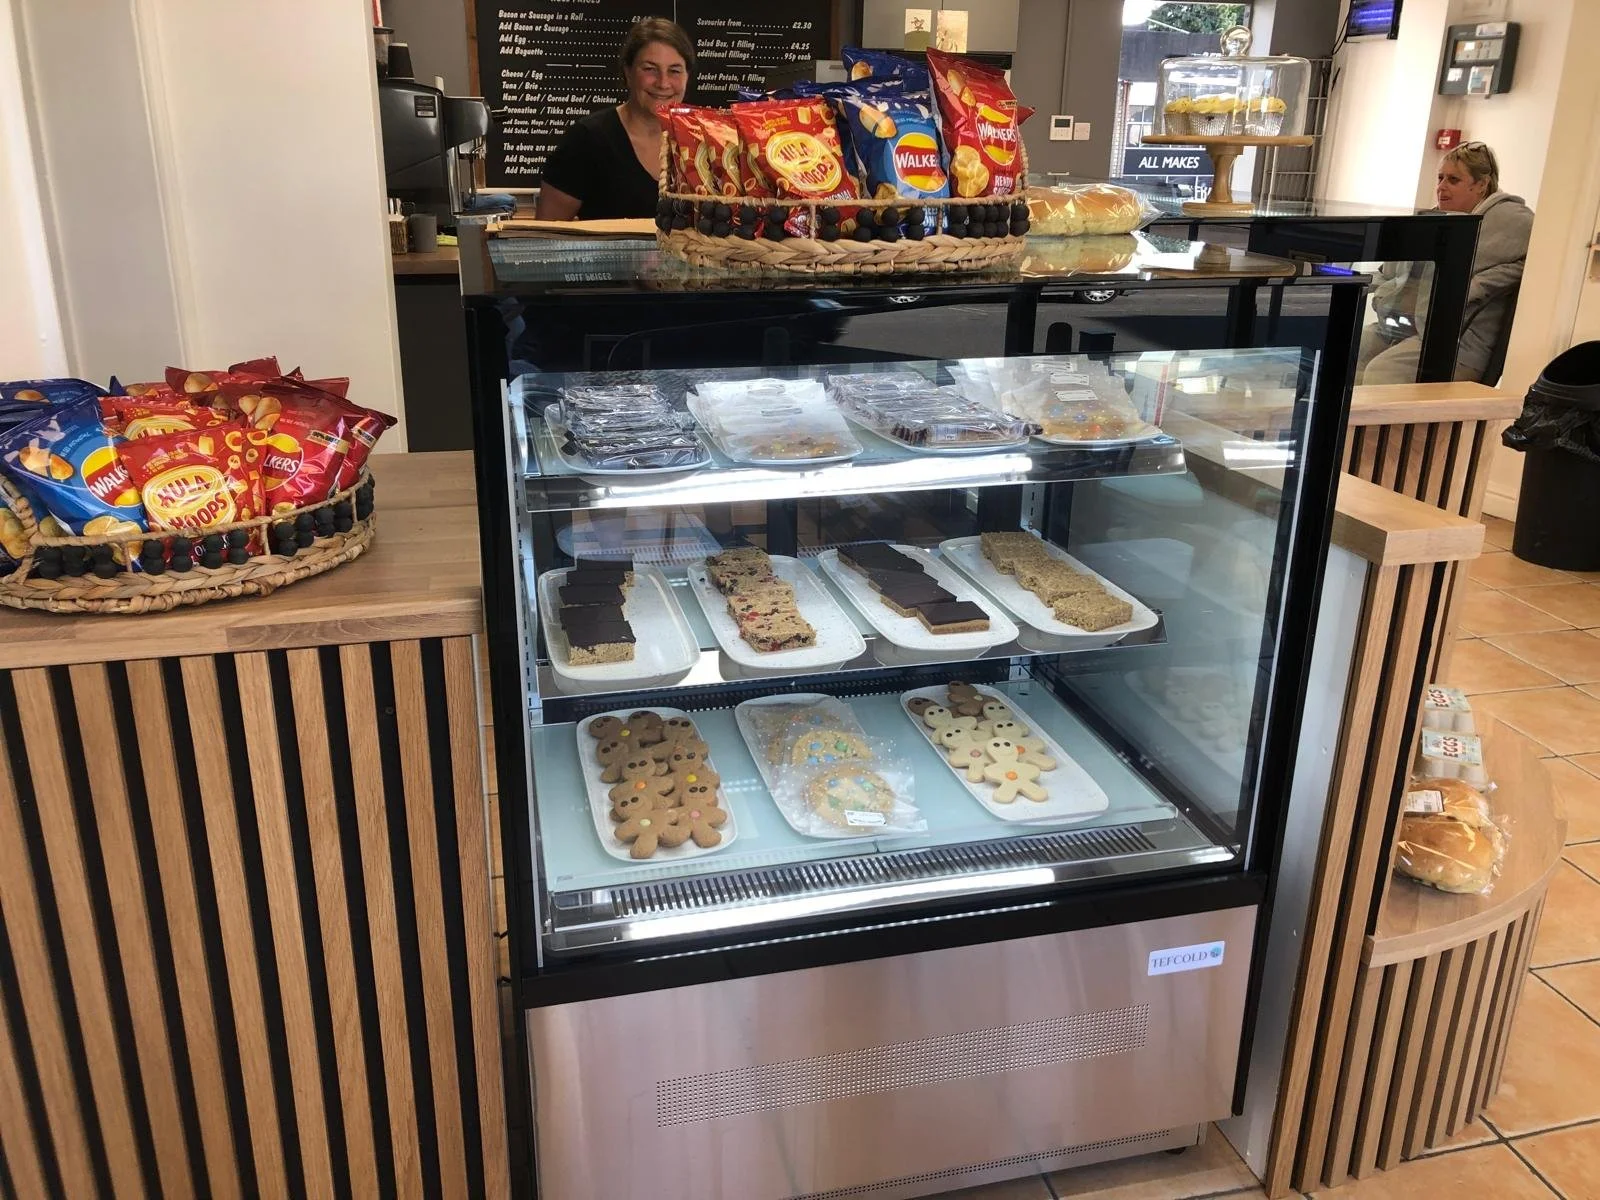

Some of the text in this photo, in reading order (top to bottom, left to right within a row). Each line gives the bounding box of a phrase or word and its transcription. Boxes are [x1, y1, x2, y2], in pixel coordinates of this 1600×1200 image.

[498, 9, 518, 19] Bacon
[528, 10, 555, 22] Sausage
[556, 11, 563, 21] in
[570, 12, 584, 21] Roll
[498, 21, 513, 31] Add
[513, 22, 534, 32] Bacon
[543, 23, 570, 35] Sausage
[696, 17, 813, 30] Savouries from £2.30
[499, 34, 527, 45] Add Egg
[696, 38, 715, 48] Salad
[736, 39, 756, 51] filling
[499, 45, 544, 57] Add Baguette
[696, 49, 812, 62] additional fillings 95p each
[501, 69, 524, 78] Cheese
[531, 70, 544, 80] Egg
[696, 72, 718, 81] Jacket
[718, 72, 740, 82] Potato,
[747, 73, 766, 84] filling
[502, 81, 517, 90] Tuna
[524, 81, 539, 91] Brie
[696, 82, 728, 92] additional
[502, 92, 518, 101] Ham
[524, 93, 541, 102] Beef
[547, 94, 570, 103] Corned
[570, 94, 587, 103] Beef
[592, 94, 618, 104] Chicken
[547, 106, 564, 115] Tikka
[565, 106, 591, 116] Chicken
[530, 119, 544, 127] Mayo
[549, 119, 565, 127] Pickle
[502, 127, 514, 135] Add
[978, 121, 1016, 142] WALKERS
[503, 142, 558, 152] The above are ser
[504, 154, 547, 165] Add Baguette
[895, 152, 938, 168] WALKE
[1138, 156, 1200, 169] ALL MAKES
[505, 166, 540, 174] Add Panini
[90, 465, 129, 498] WALK
[157, 475, 211, 508] HULA
[168, 491, 228, 530] HOOPS
[1428, 689, 1450, 708] EGGS
[1442, 736, 1459, 758] EGGS
[1151, 951, 1208, 969] TEFCOLD
